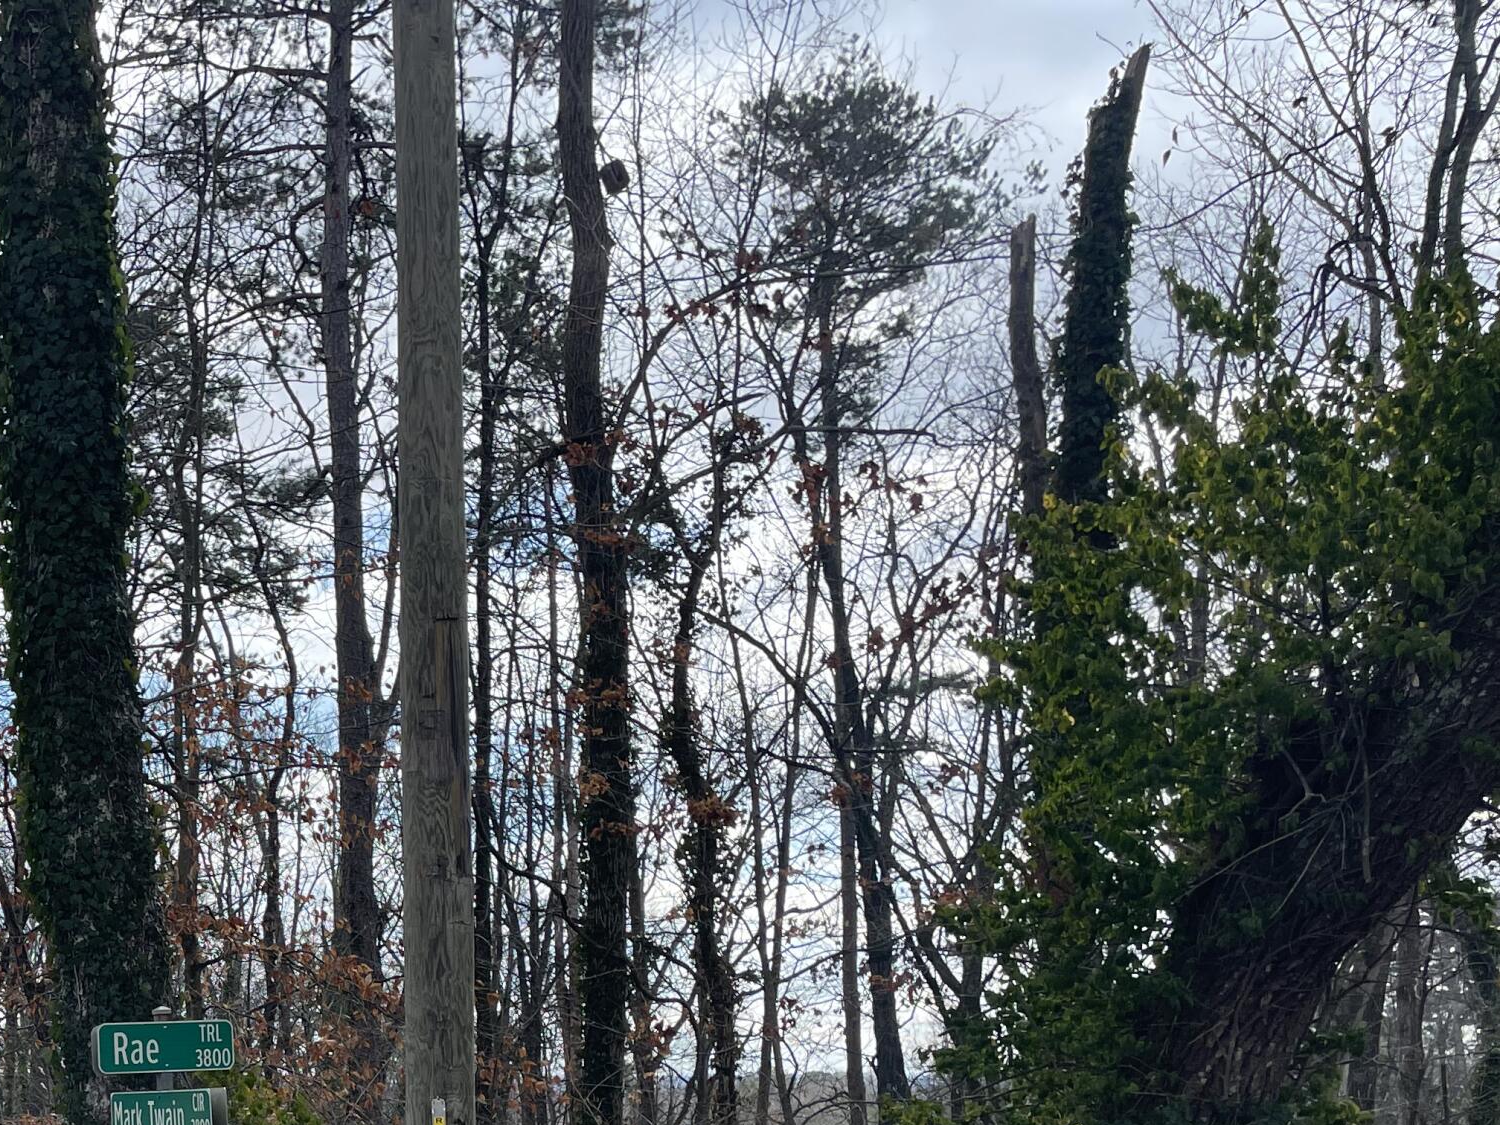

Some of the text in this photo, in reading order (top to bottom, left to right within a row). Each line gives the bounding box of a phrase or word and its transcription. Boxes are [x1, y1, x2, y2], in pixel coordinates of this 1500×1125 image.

[198, 1023, 223, 1043] TRL
[113, 1032, 160, 1065] Rae
[195, 1048, 231, 1067] 3800
[192, 1093, 205, 1112] CIR
